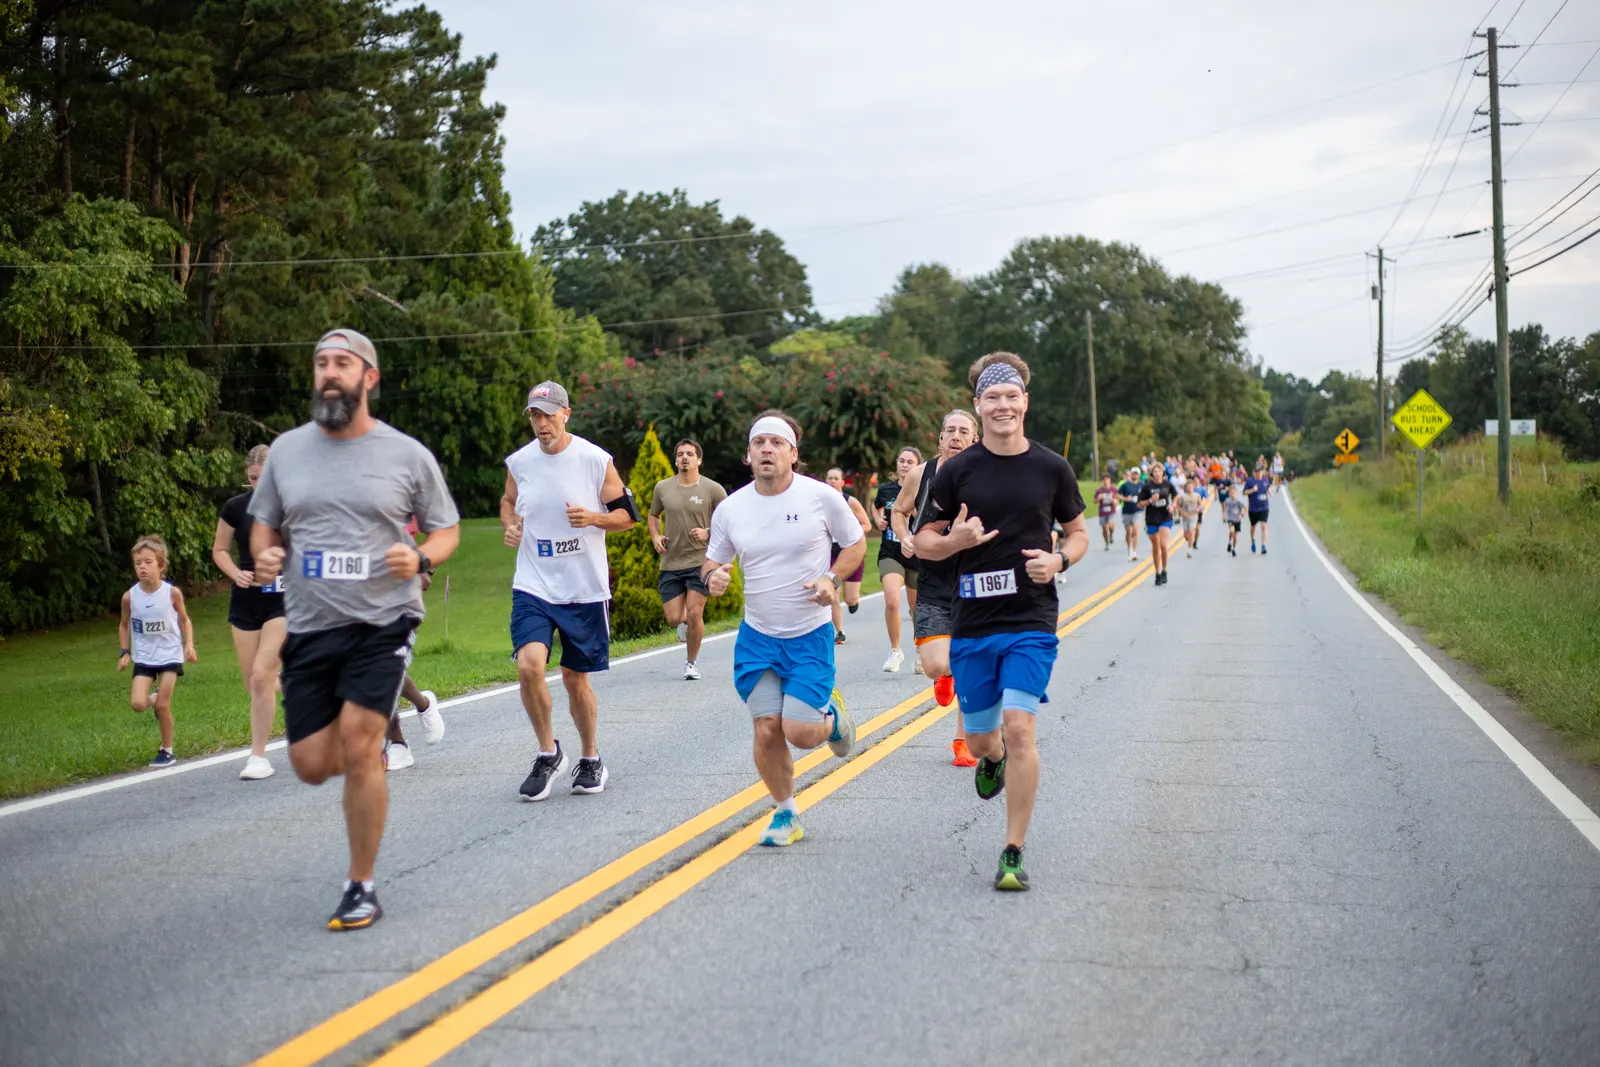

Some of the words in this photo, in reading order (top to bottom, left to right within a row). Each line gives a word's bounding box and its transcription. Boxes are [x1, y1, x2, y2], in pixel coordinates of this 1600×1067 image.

[1406, 403, 1437, 413] SCHOOL
[1400, 415, 1417, 424] BUS
[1421, 415, 1443, 424] TURN
[1408, 426, 1436, 435] AHEAD
[555, 538, 581, 554] 2232
[328, 555, 363, 575] 2160
[979, 573, 1010, 592] 1967
[145, 620, 166, 632] 2221
